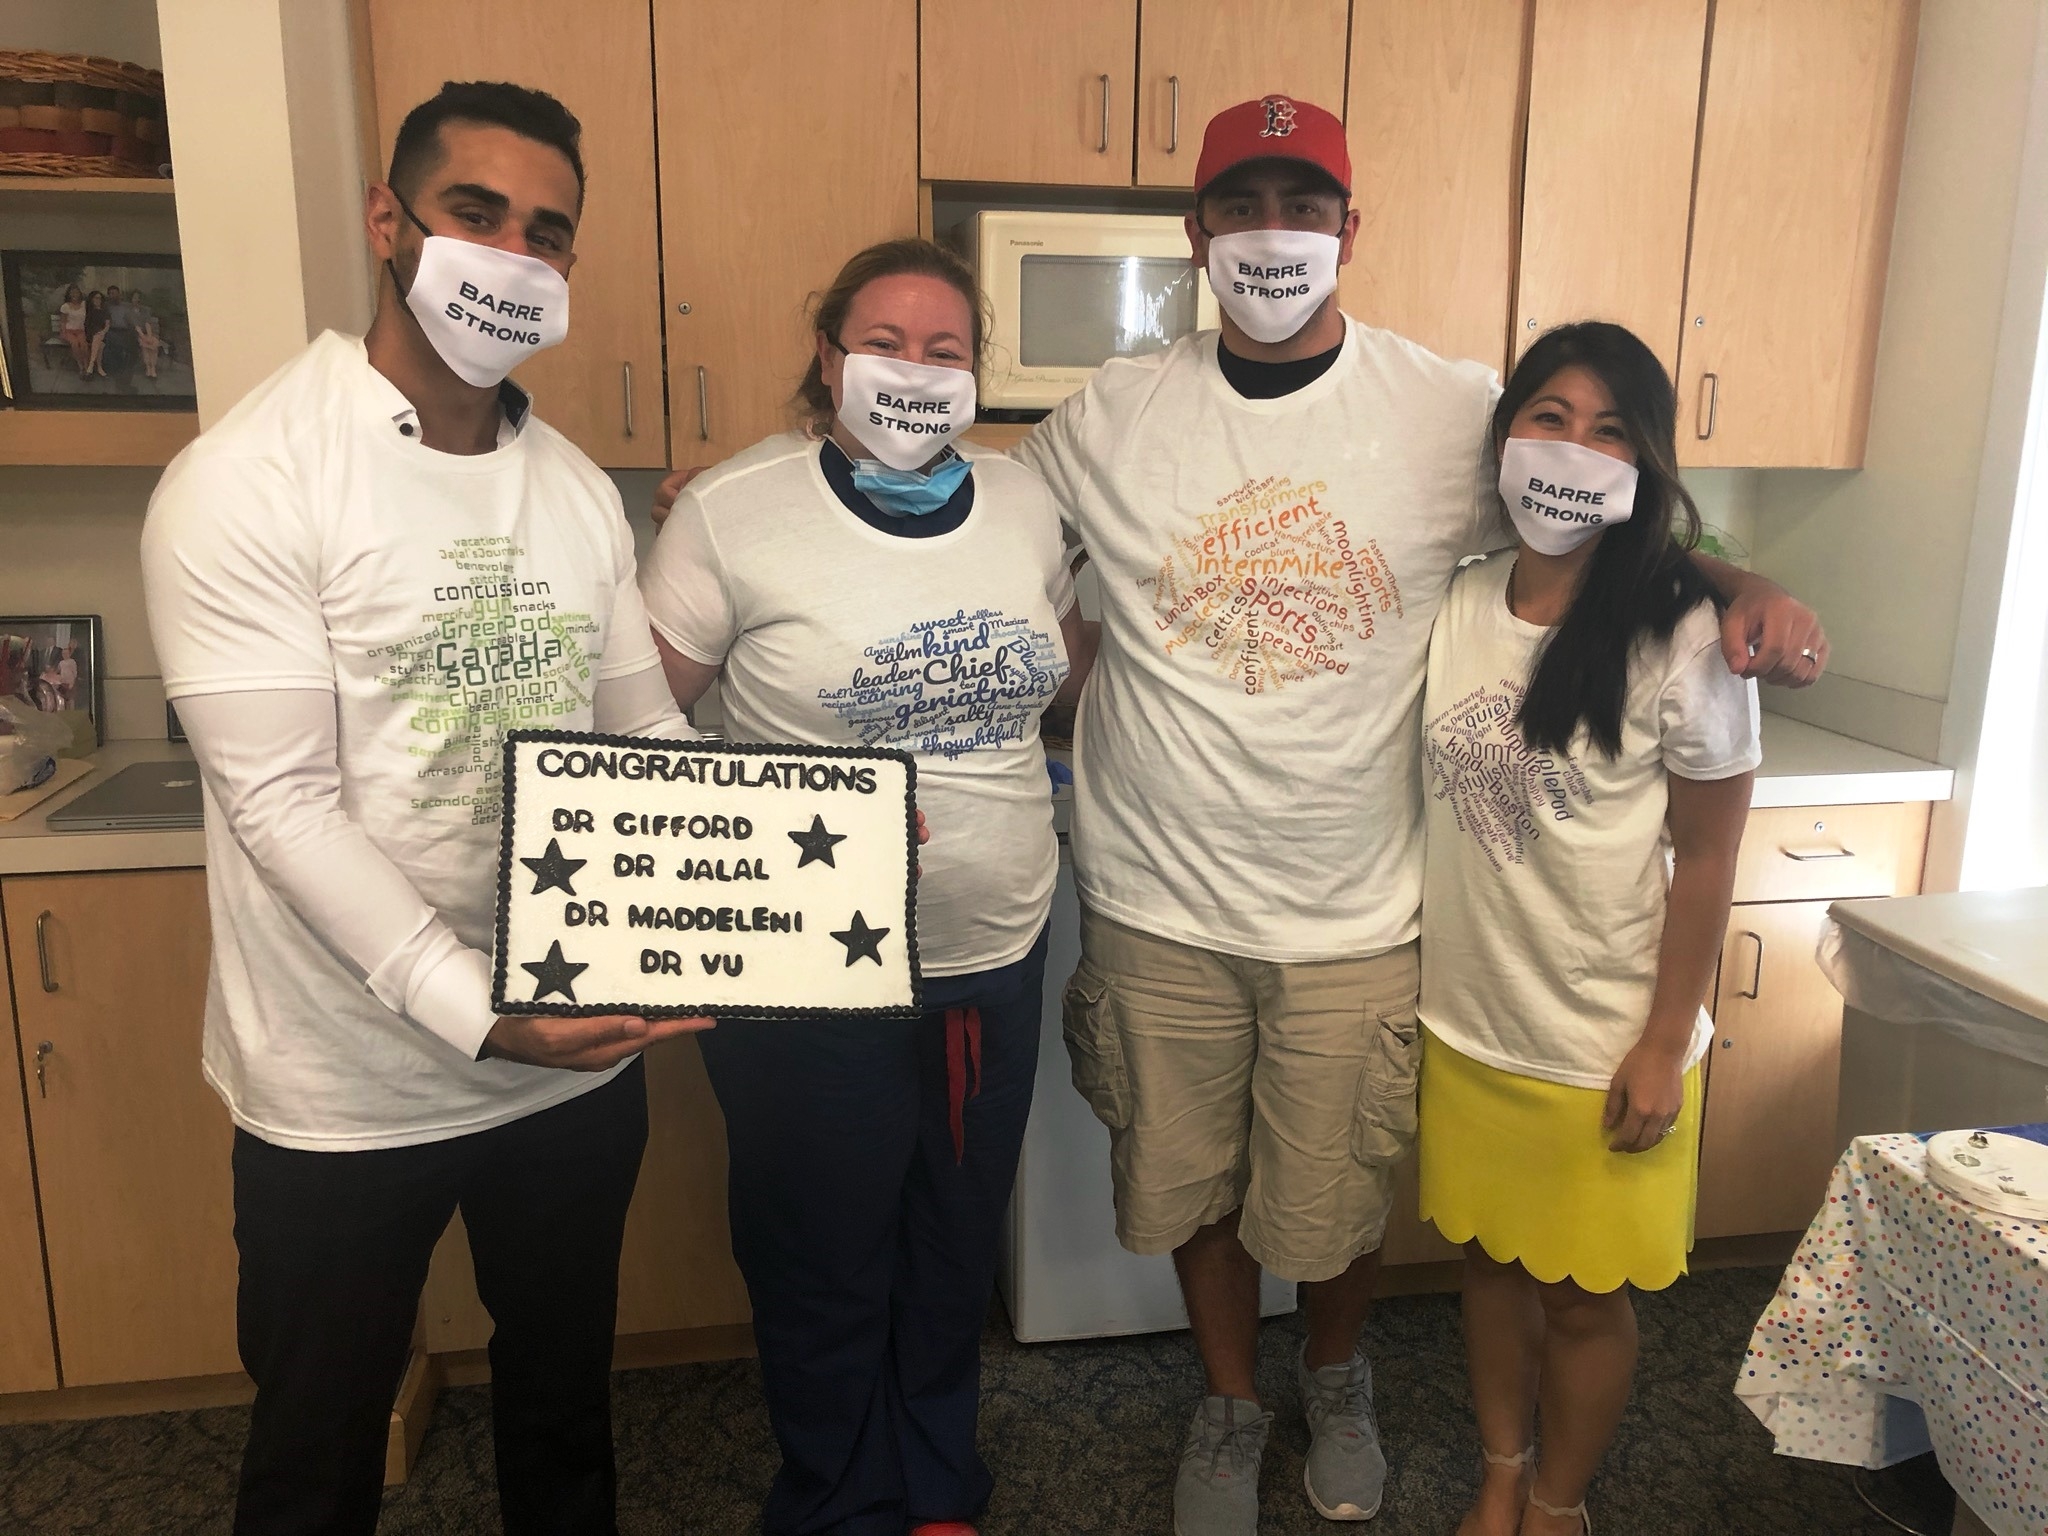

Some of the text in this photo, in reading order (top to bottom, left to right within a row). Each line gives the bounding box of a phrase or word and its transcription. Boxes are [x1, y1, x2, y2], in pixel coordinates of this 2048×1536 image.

[1259, 99, 1298, 138] B
[1009, 239, 1044, 247] Panasonic
[1238, 262, 1308, 280] BARRE
[459, 281, 544, 322] BARRE
[1233, 281, 1310, 299] STRONG
[445, 302, 541, 345] STRONG
[876, 392, 951, 414] BARRE
[869, 411, 951, 434] STRONG
[1217, 479, 1256, 507] sandwich
[1264, 476, 1291, 498] caring
[1528, 477, 1606, 505] BARRE
[1197, 481, 1327, 529] Transformers
[1520, 495, 1603, 524] STRONG
[1193, 527, 1218, 542] lively
[1203, 496, 1322, 555] efficient
[1302, 512, 1333, 538] reliable
[1318, 525, 1335, 546] kind
[453, 536, 511, 547] vacations
[1182, 538, 1200, 556] Holly
[1244, 538, 1279, 558] CoolCat
[1270, 547, 1295, 558] blunt
[1196, 551, 1344, 579] InternMike
[1136, 576, 1156, 589] funny
[1301, 576, 1339, 600] intuitive
[1333, 520, 1375, 640] moonlighting
[1357, 548, 1391, 613] resorts
[513, 601, 555, 612] snacks
[1155, 574, 1226, 632] LunchBox
[1261, 571, 1348, 620] injections
[422, 608, 474, 622] merciful
[473, 598, 512, 621] gyn
[910, 609, 967, 633] sweet
[966, 608, 1003, 622] selfless
[1164, 575, 1243, 656] MuscleCars
[1205, 596, 1248, 648] Celtics
[565, 622, 600, 634] mindful
[943, 622, 975, 636] smart
[988, 618, 1029, 629] Mexican
[1262, 618, 1290, 635] Krista
[1311, 611, 1336, 645] obliging
[1329, 620, 1355, 632] chips
[367, 626, 440, 657] organized
[923, 622, 990, 659] kind
[1211, 614, 1248, 660] ChronicPain
[1313, 642, 1344, 651] smart
[398, 649, 434, 662] PTSD
[551, 622, 591, 682] active
[863, 646, 895, 657] Annie
[874, 641, 922, 665] calm
[1241, 610, 1260, 695] confident
[1260, 631, 1350, 675] PeachPod
[853, 662, 921, 689] leader
[923, 646, 1011, 685] Chief
[1229, 659, 1244, 680] Dory
[1259, 644, 1284, 690] basketball
[1280, 671, 1304, 682] quiet
[1295, 659, 1318, 678] BRAT
[374, 674, 447, 688] respectful
[817, 687, 881, 699] LastNames
[959, 680, 976, 690] tea
[1257, 667, 1266, 694] smile
[516, 694, 554, 705] smart
[857, 682, 923, 705] caring
[895, 677, 1036, 730] geriatrics
[1480, 694, 1504, 704] bride
[821, 700, 857, 713] recipes
[914, 707, 949, 729] diligent
[944, 704, 994, 727] salty
[1429, 685, 1485, 730] warm-hearted
[1450, 702, 1480, 726] Denise
[1465, 695, 1512, 730] quiet
[848, 715, 895, 728] generous
[857, 723, 881, 739] witty
[1440, 724, 1472, 737] serious
[1466, 723, 1492, 743] bright
[472, 726, 484, 762] polite
[886, 725, 955, 744] hard-working
[921, 721, 1018, 755] thoughtful
[1494, 711, 1540, 776] humble
[1436, 745, 1470, 773] TopChef
[1446, 735, 1484, 772] kind
[418, 762, 493, 778] ultrasound
[536, 748, 878, 795] CONGRATULATIONS
[1458, 760, 1513, 795] stylish
[1433, 785, 1450, 801] Tara
[1527, 777, 1546, 807] happy
[1563, 770, 1580, 796] chica
[1463, 797, 1486, 834] Karaoke
[1469, 792, 1499, 844] passionate
[1479, 792, 1515, 838] easygoing
[1488, 780, 1540, 840] Boston
[1491, 795, 1510, 818] busy
[552, 808, 753, 840] DR GIFFORD
[1463, 809, 1502, 873] conscientious
[1494, 823, 1515, 861] creative
[613, 853, 770, 881] DR JALAL
[564, 900, 803, 933] DR MADDELENI
[640, 948, 743, 977] DR VU
